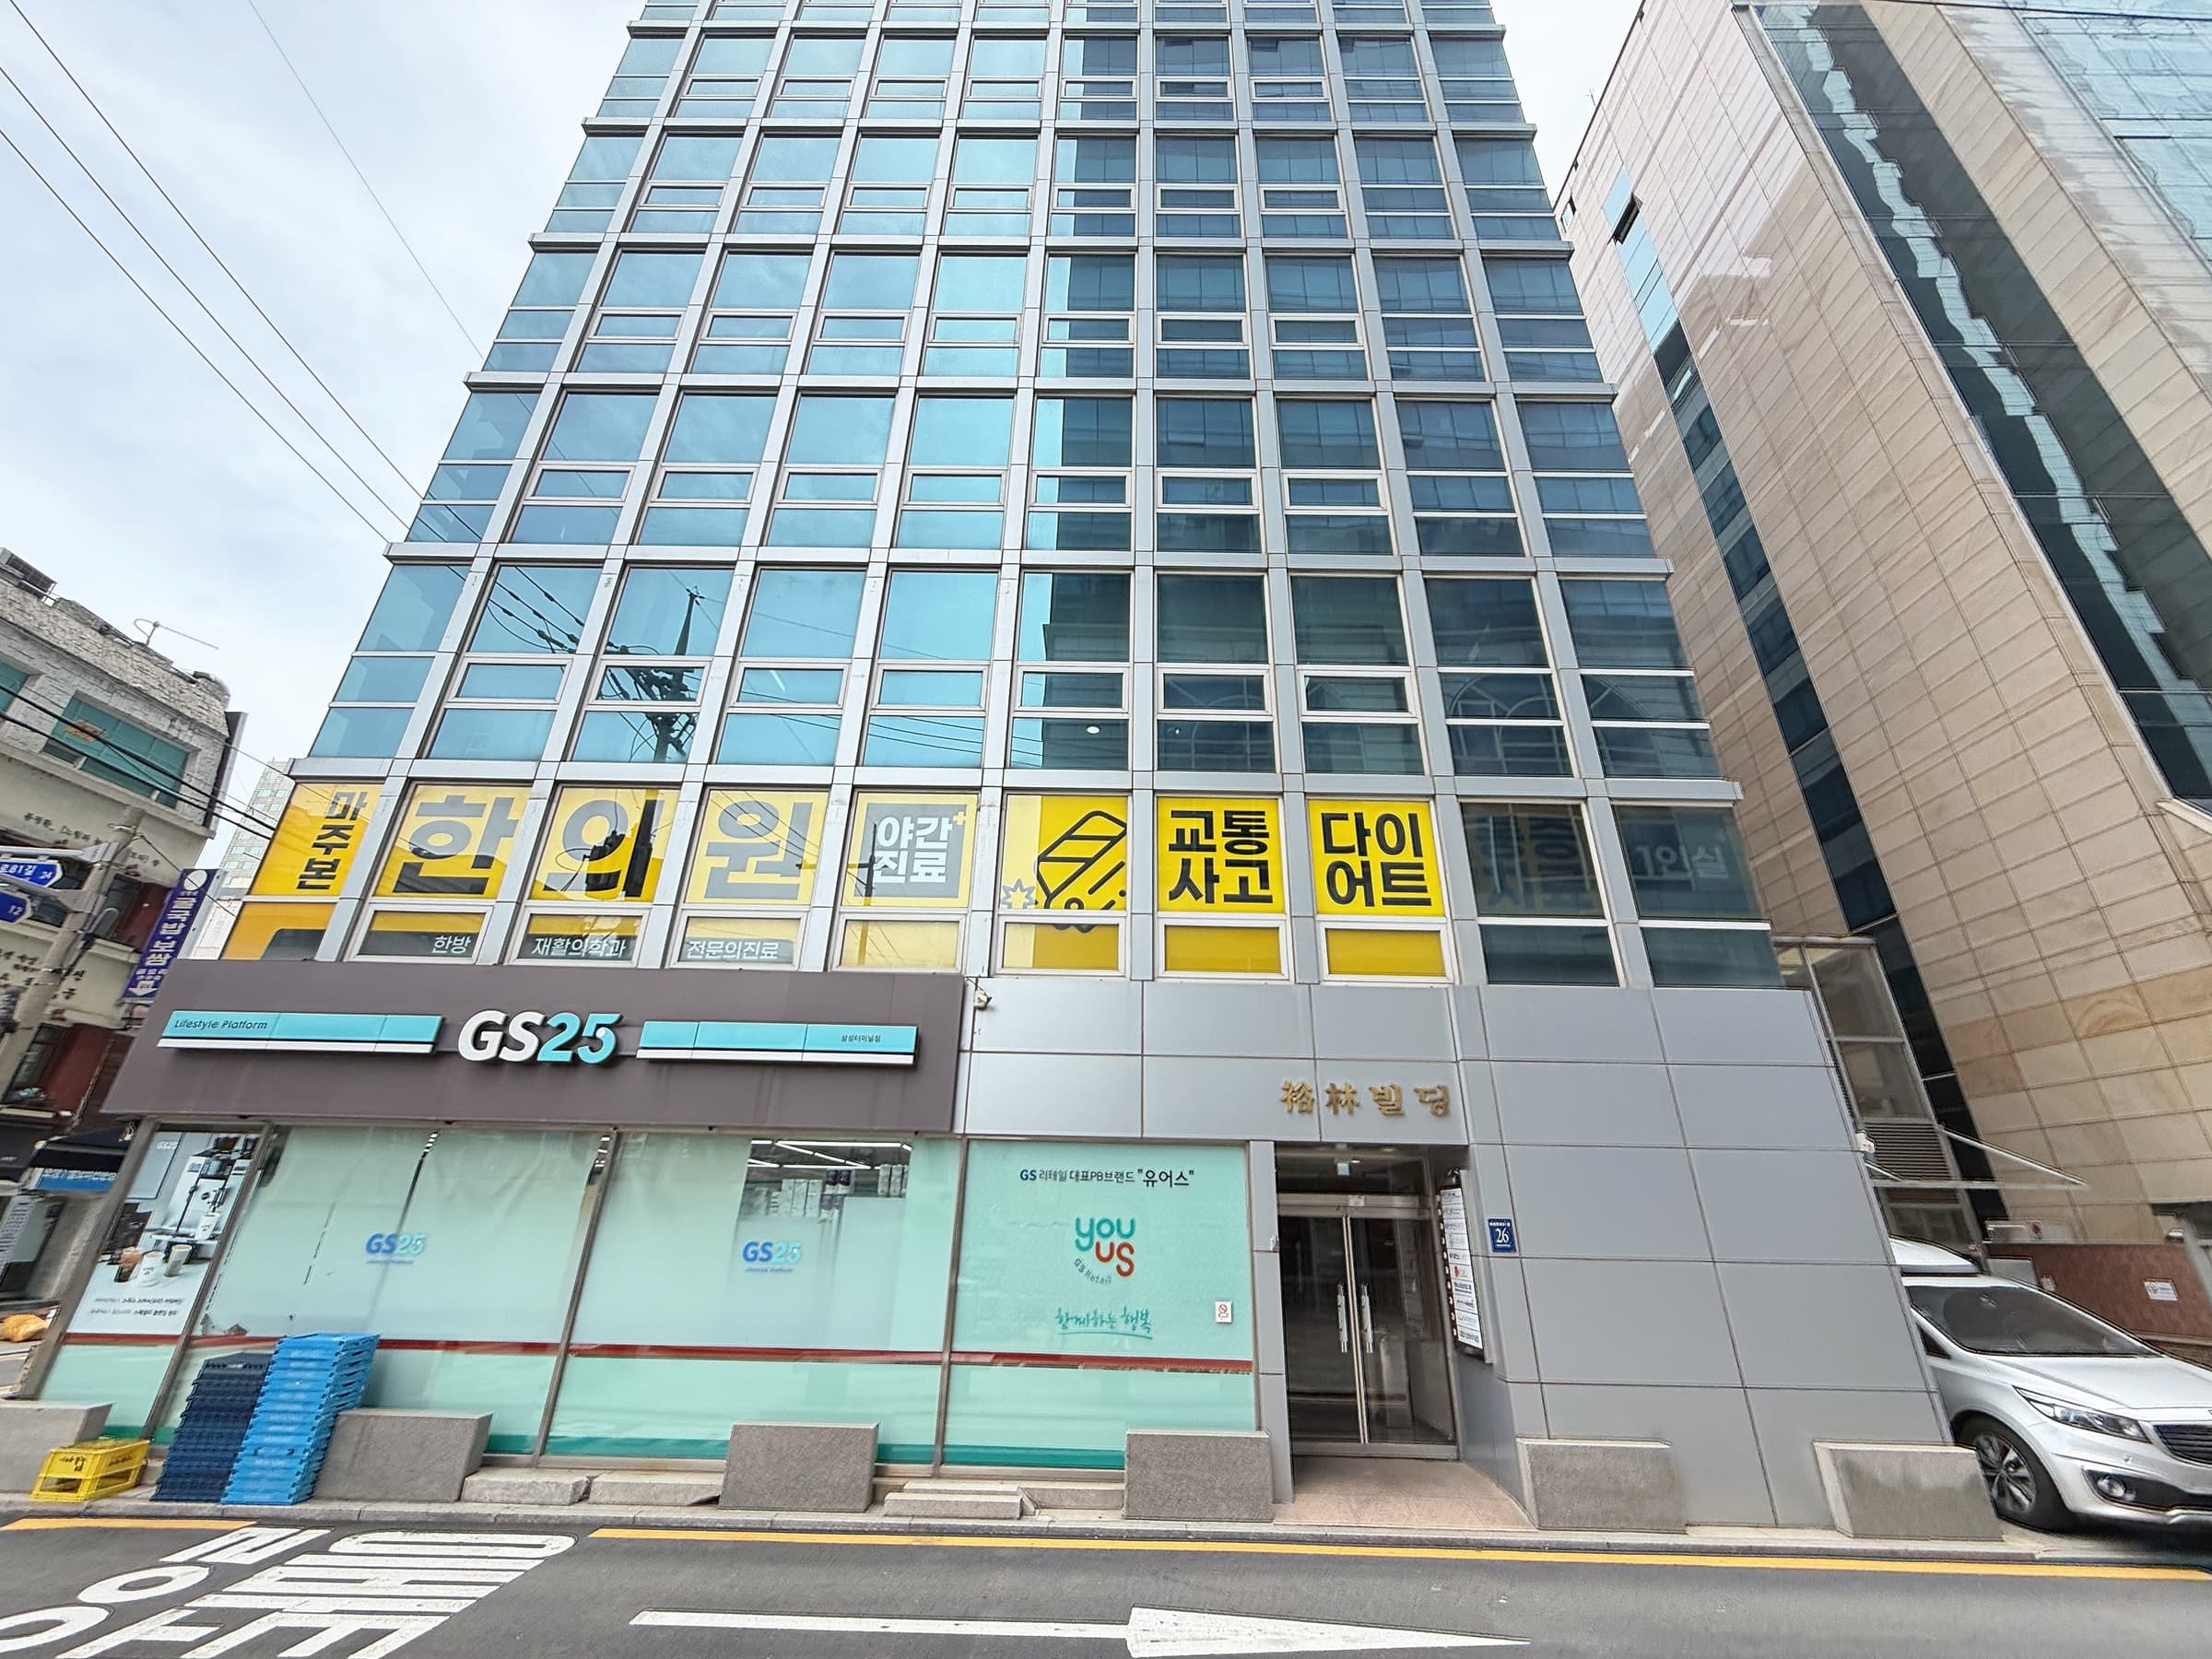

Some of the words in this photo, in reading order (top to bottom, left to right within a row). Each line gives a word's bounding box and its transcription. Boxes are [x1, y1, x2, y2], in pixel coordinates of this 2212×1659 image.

[296, 791, 368, 890] 마주본
[393, 794, 814, 900] 한의원
[877, 816, 952, 848] 야간
[1168, 810, 1269, 854] 교통
[1322, 812, 1423, 857] 다이
[873, 849, 947, 886] 진료
[1168, 857, 1274, 905] 사고
[1325, 861, 1432, 907] 어트
[432, 935, 472, 956] 한방
[531, 936, 627, 959] 재활의학과
[687, 942, 779, 960] 전문의진료
[174, 1019, 218, 1030] Lifestyle
[222, 1019, 267, 1030] Platform
[458, 1010, 620, 1063] GS25
[1019, 1169, 1037, 1182] GS
[1039, 1170, 1066, 1182] 리테일
[1069, 1171, 1135, 1183] 대표PB브랜드
[365, 1232, 427, 1254] GS25
[742, 1241, 802, 1264] GS25
[1075, 1217, 1136, 1252] you
[1495, 1227, 1509, 1243] 26
[1095, 1241, 1135, 1277] us
